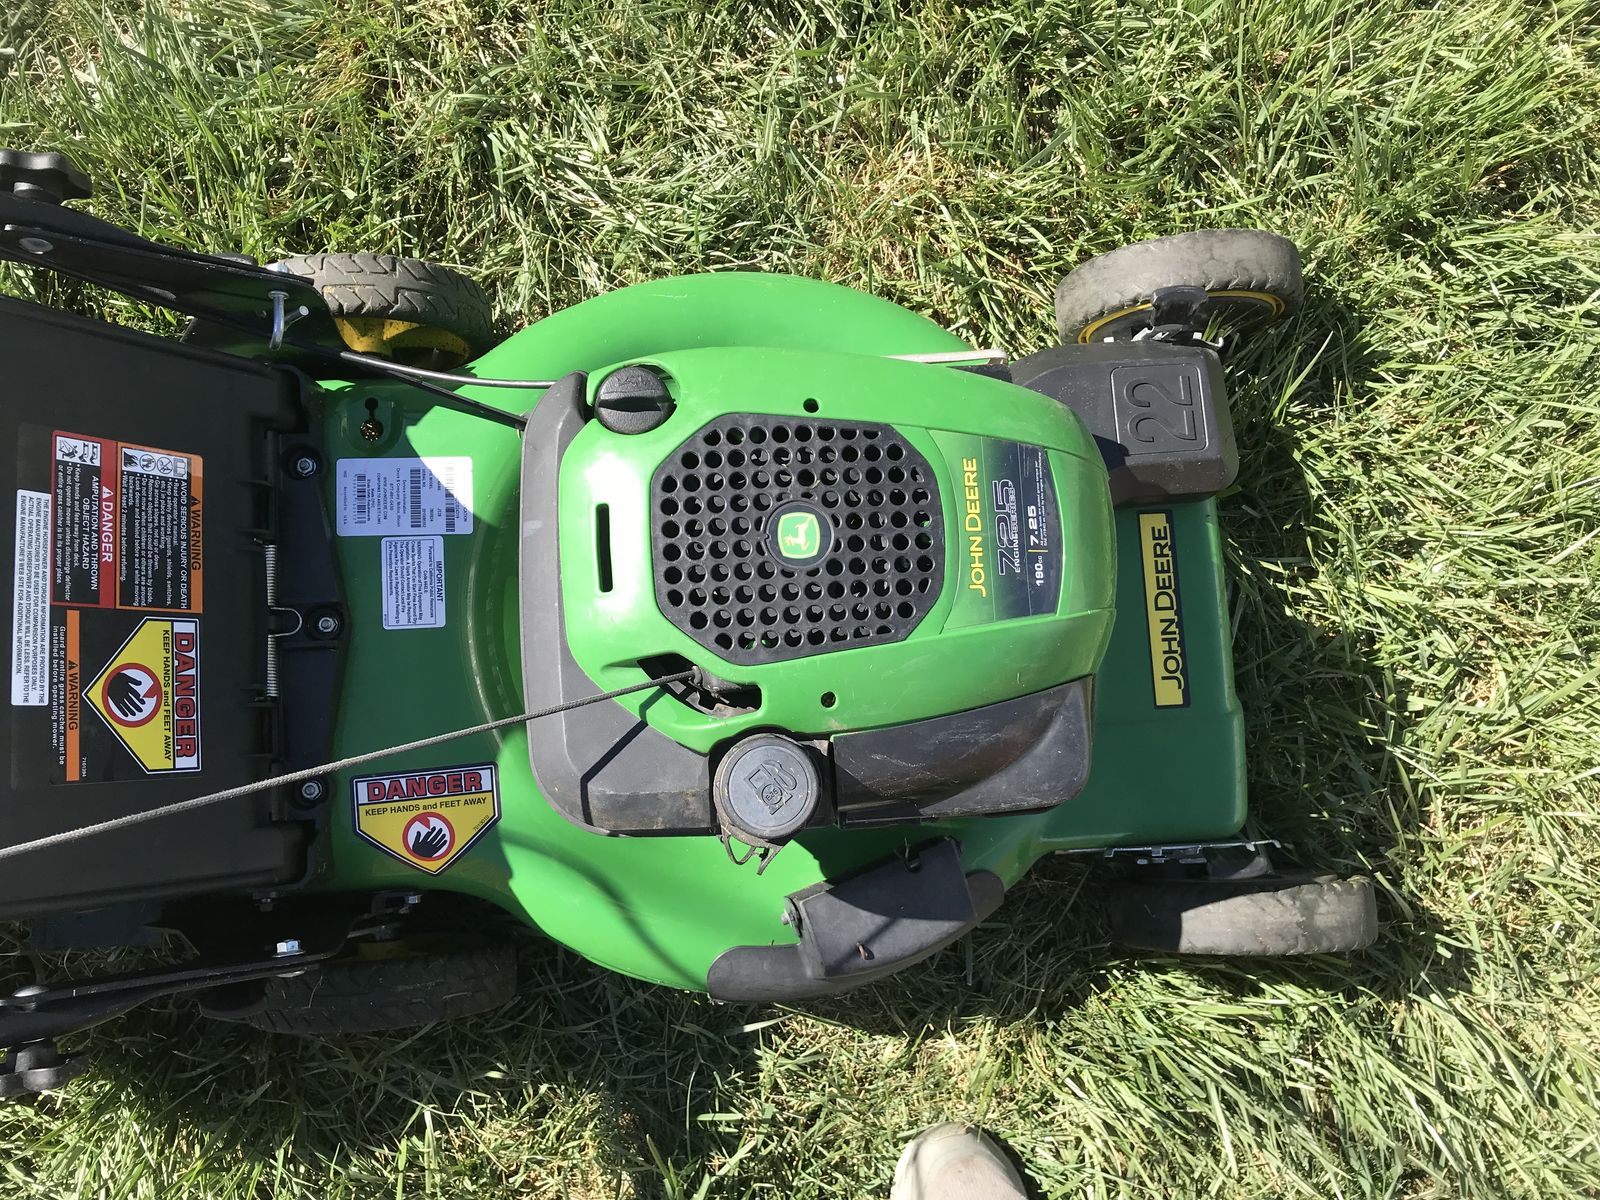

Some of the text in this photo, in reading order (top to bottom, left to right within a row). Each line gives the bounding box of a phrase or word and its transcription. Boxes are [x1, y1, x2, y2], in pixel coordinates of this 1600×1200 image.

[1123, 375, 1197, 444] 22
[67, 466, 72, 474] Do
[142, 478, 147, 486] Do
[154, 480, 160, 488] Go
[102, 502, 112, 562] DANGER
[191, 510, 202, 570] WARNING
[962, 458, 987, 598] JOHN DEERE
[992, 479, 1016, 576] 725
[1028, 505, 1039, 546] 7.25
[1012, 533, 1020, 573] ENGINE
[180, 570, 187, 581] OR
[1151, 526, 1182, 690] JOHN DEERE
[69, 672, 78, 730] WARNING
[174, 632, 196, 758] DANGER
[59, 756, 65, 765] be
[365, 807, 388, 816] KEEP
[390, 804, 420, 814] HANDS
[440, 800, 461, 808] FEET
[464, 797, 487, 806] AWAY
[366, 772, 482, 802] DANGER
